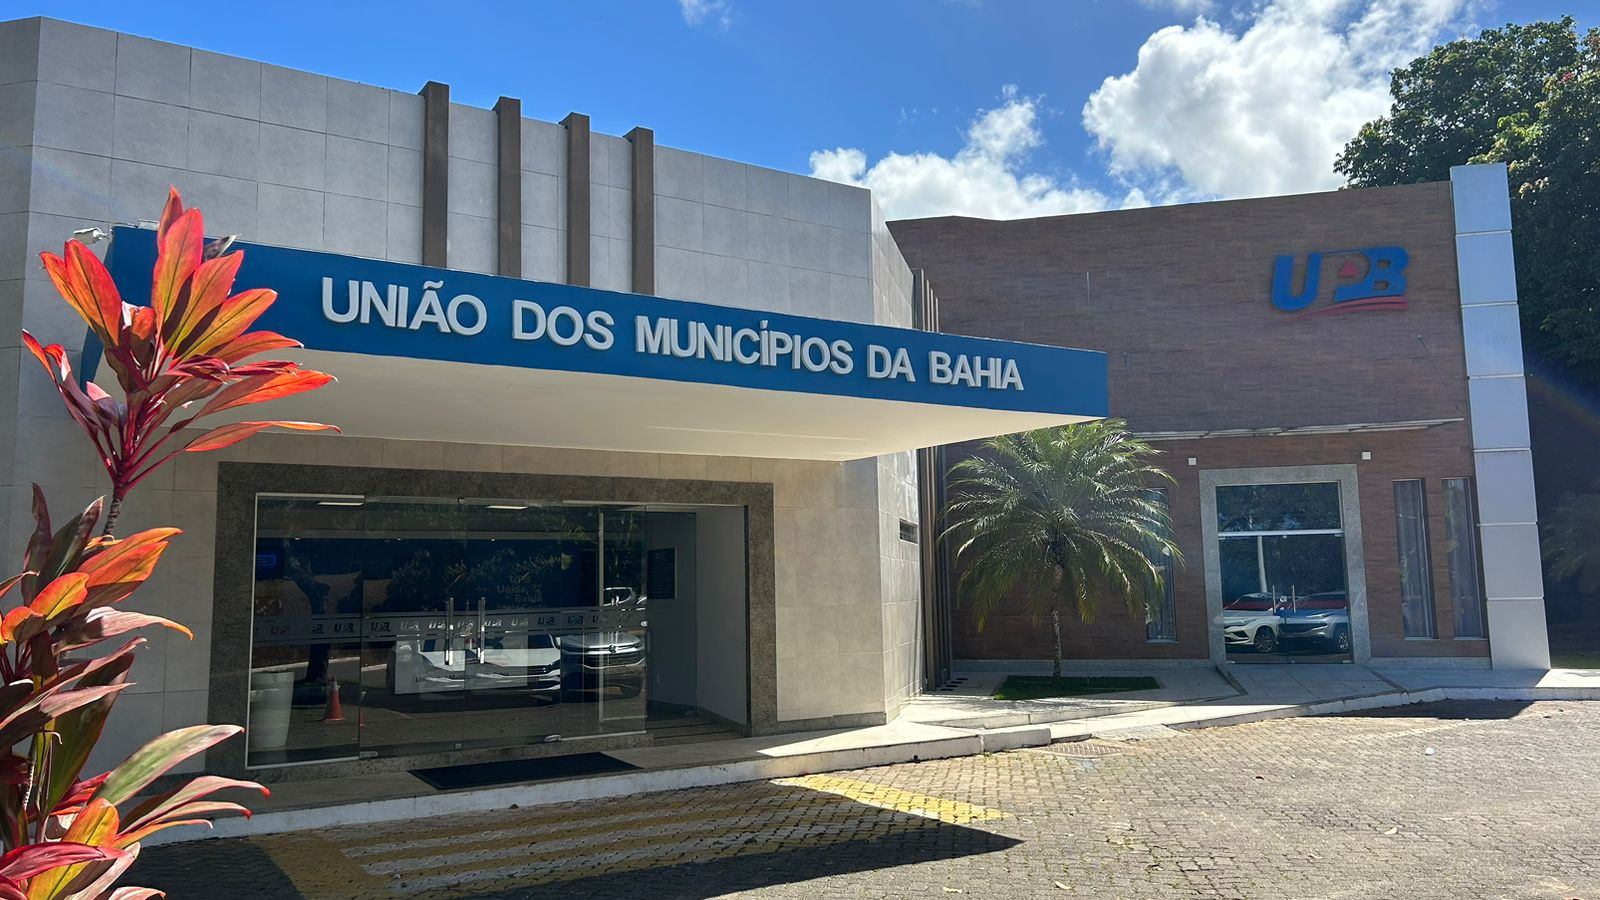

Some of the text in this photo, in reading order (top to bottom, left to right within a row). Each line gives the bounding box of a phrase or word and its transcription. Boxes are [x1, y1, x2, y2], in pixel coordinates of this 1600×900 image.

[1272, 246, 1409, 311] UPB
[321, 276, 1024, 391] UNIÃO DOS MUNICÍPIOS DA BAHIA
